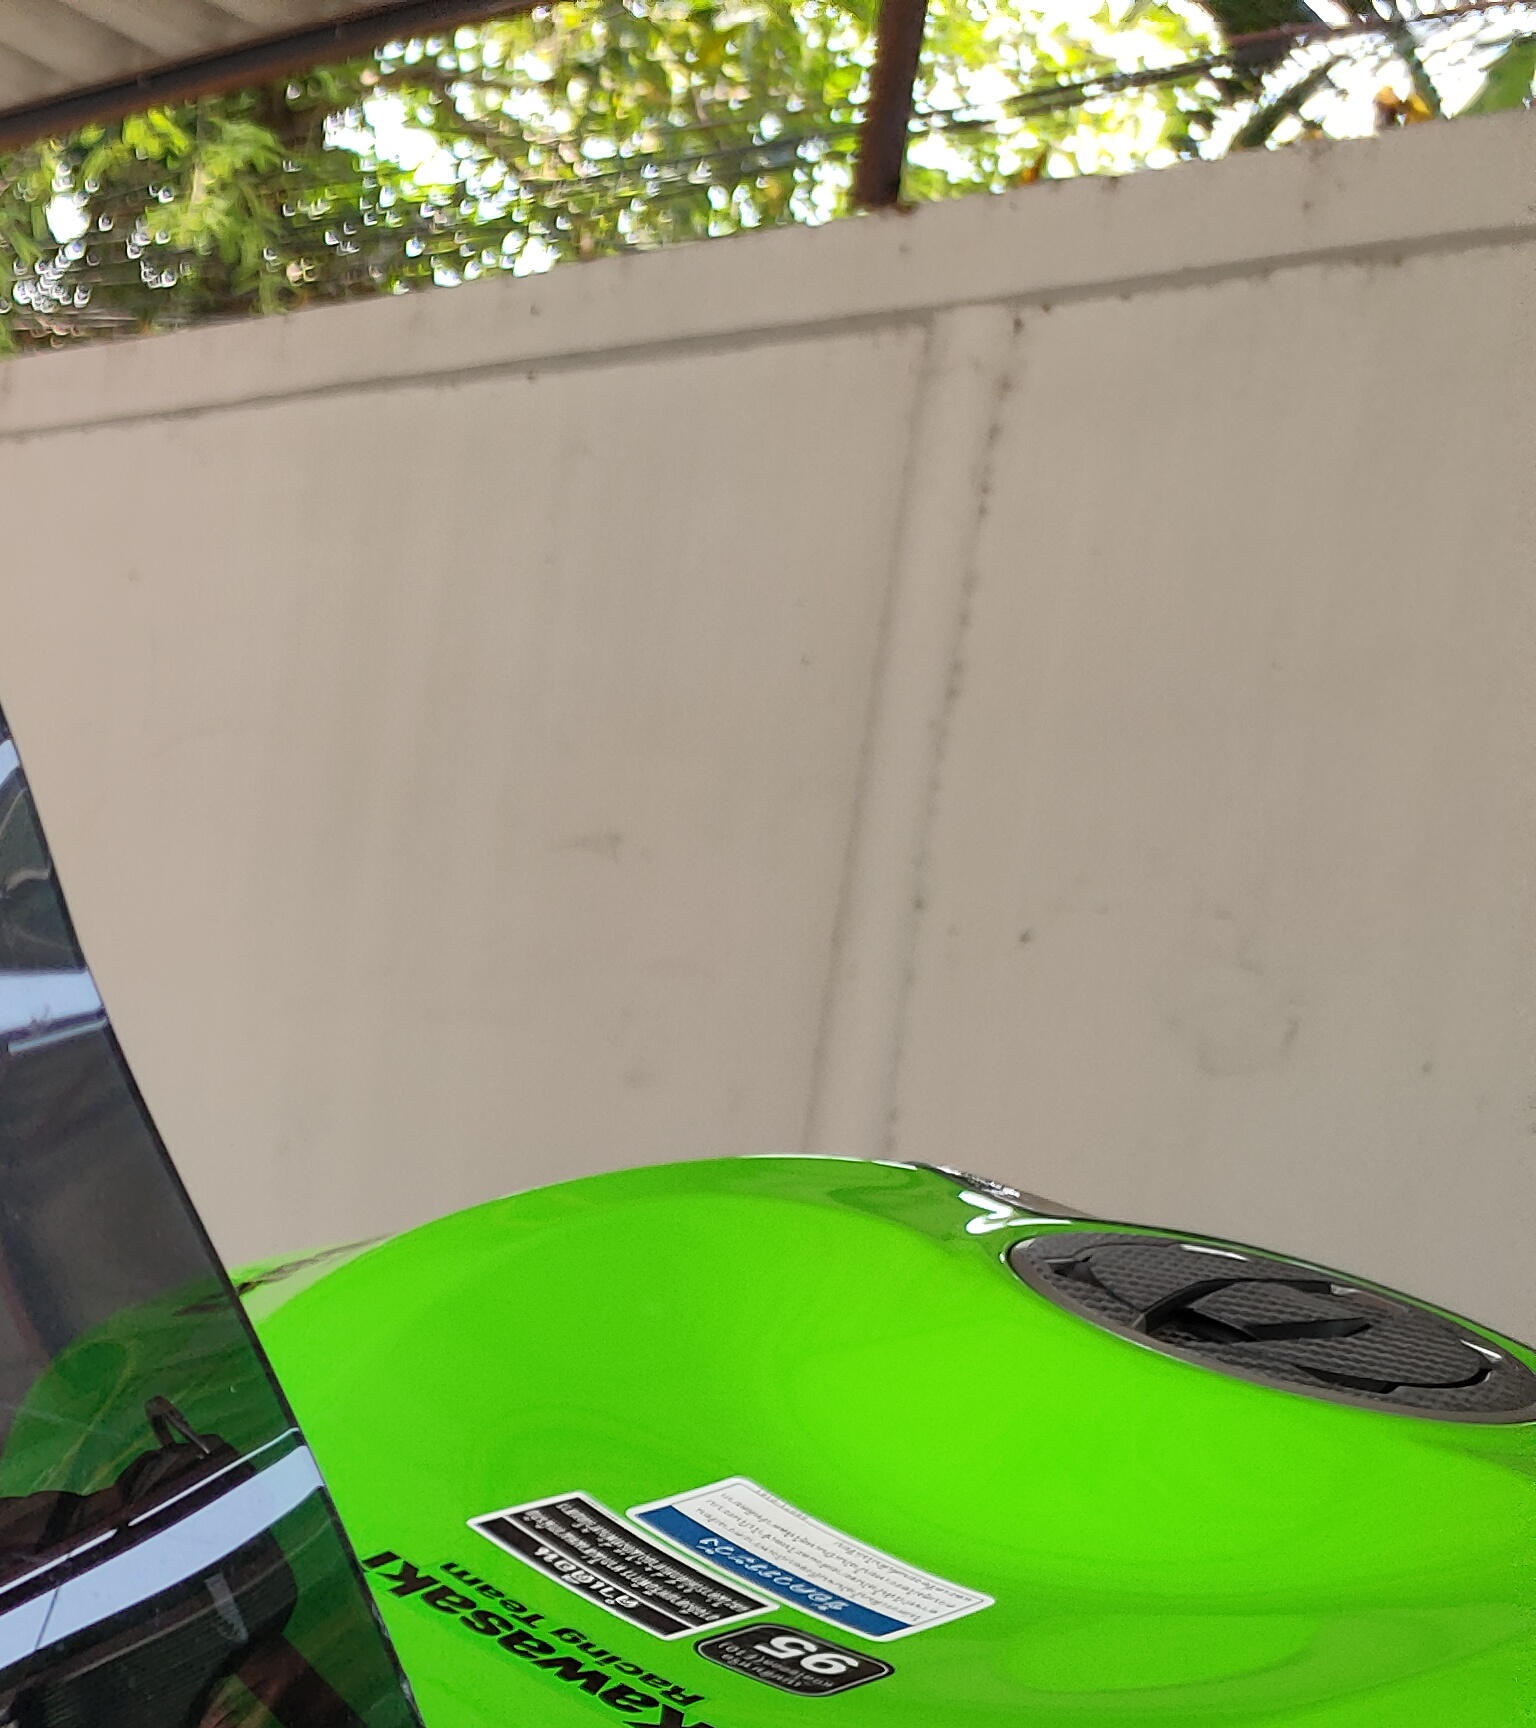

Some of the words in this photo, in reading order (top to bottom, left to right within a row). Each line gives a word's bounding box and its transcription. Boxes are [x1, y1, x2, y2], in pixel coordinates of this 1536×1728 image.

[440, 1561, 545, 1629] Team
[533, 1546, 642, 1609] คำเตือน
[548, 1627, 706, 1706] Racing
[753, 1636, 859, 1675] 95
